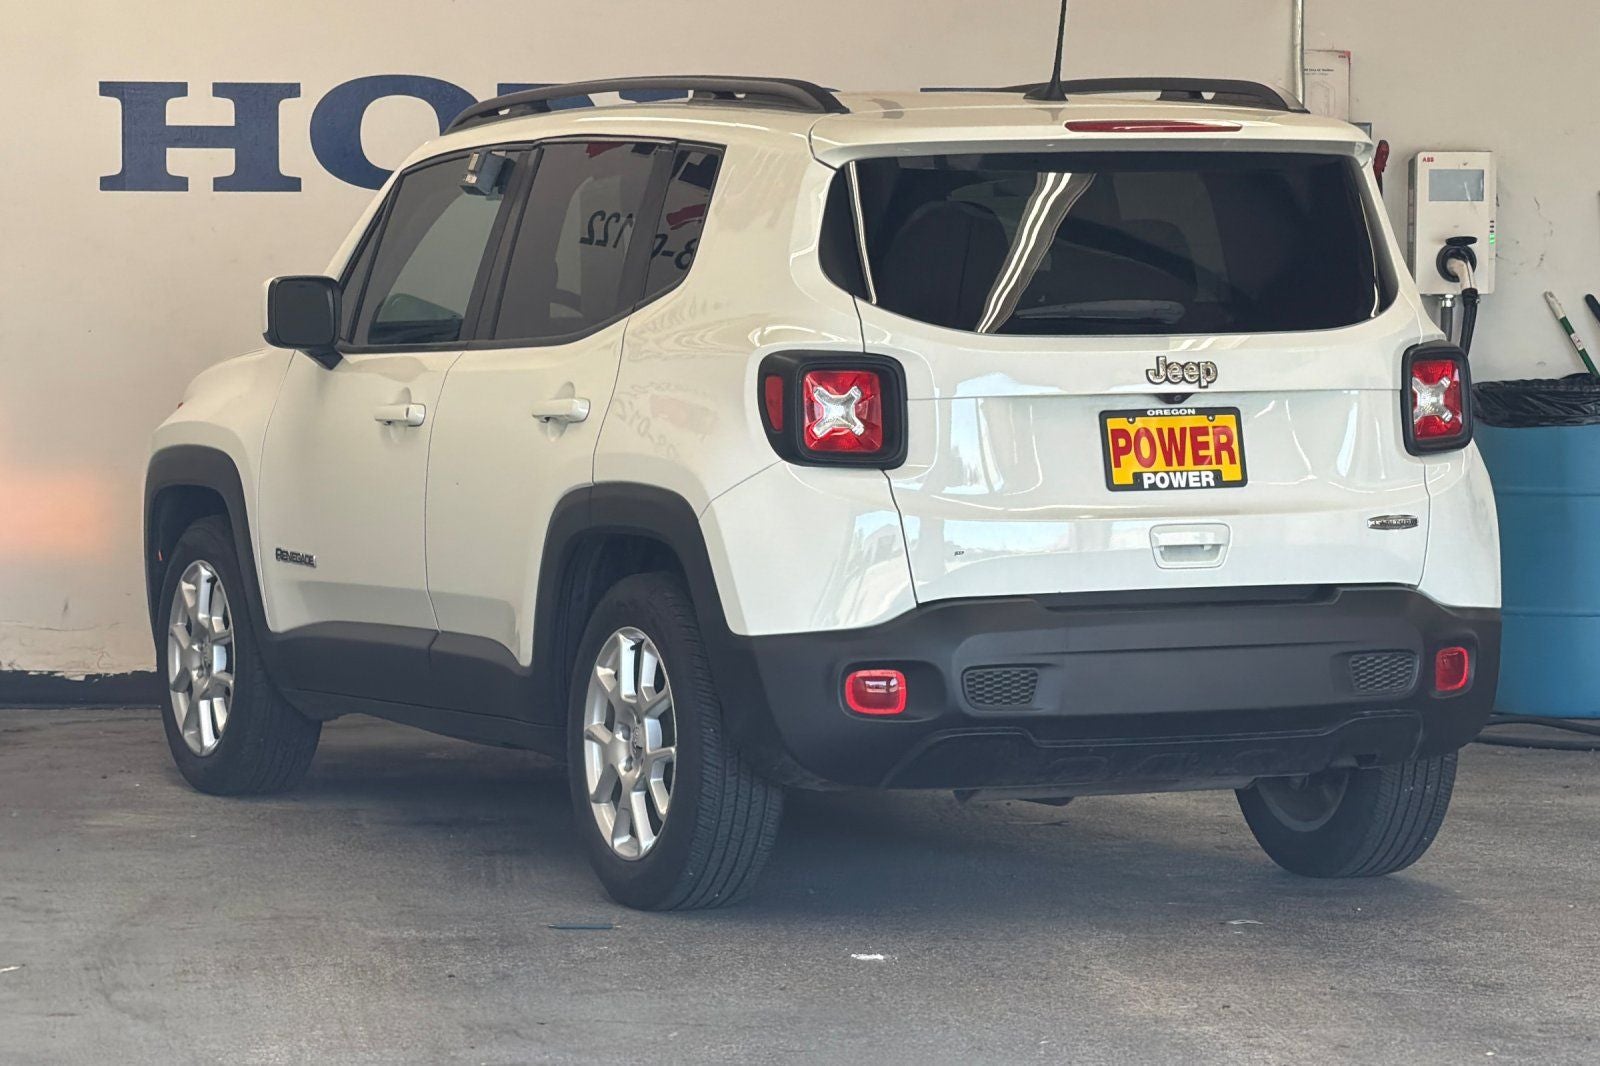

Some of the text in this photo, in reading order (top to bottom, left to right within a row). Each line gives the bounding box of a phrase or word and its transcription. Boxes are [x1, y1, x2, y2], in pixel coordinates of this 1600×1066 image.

[1146, 356, 1218, 388] Jeep
[1147, 408, 1196, 416] OREGON
[1110, 425, 1237, 469] POWER
[1143, 470, 1215, 489] POWER
